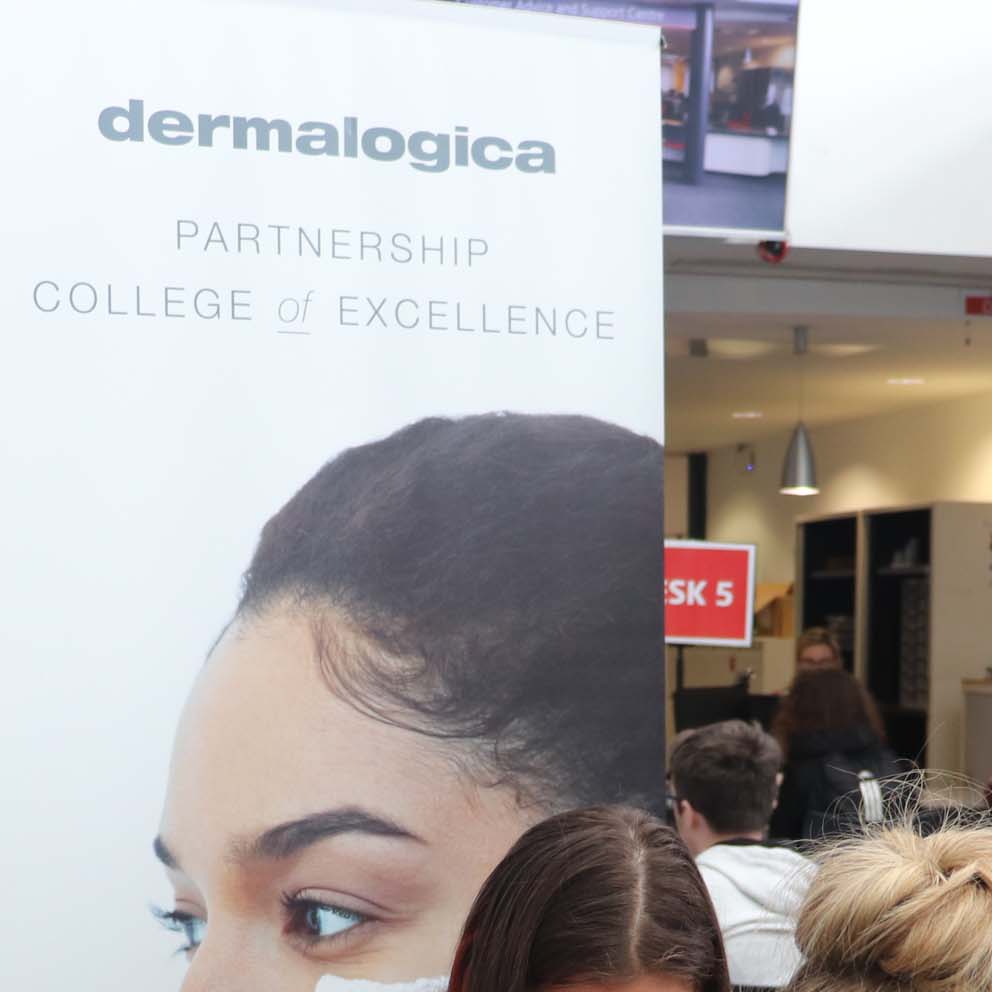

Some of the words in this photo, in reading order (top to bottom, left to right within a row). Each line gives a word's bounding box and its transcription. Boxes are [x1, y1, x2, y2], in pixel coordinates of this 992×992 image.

[98, 98, 556, 174] dermalogica
[176, 220, 488, 267] PARTNERSHIP
[33, 280, 252, 321] COLLEGE
[277, 290, 315, 326] of
[339, 296, 615, 340] EXCELLENCE
[664, 579, 708, 606] SK
[715, 581, 735, 607] 5
